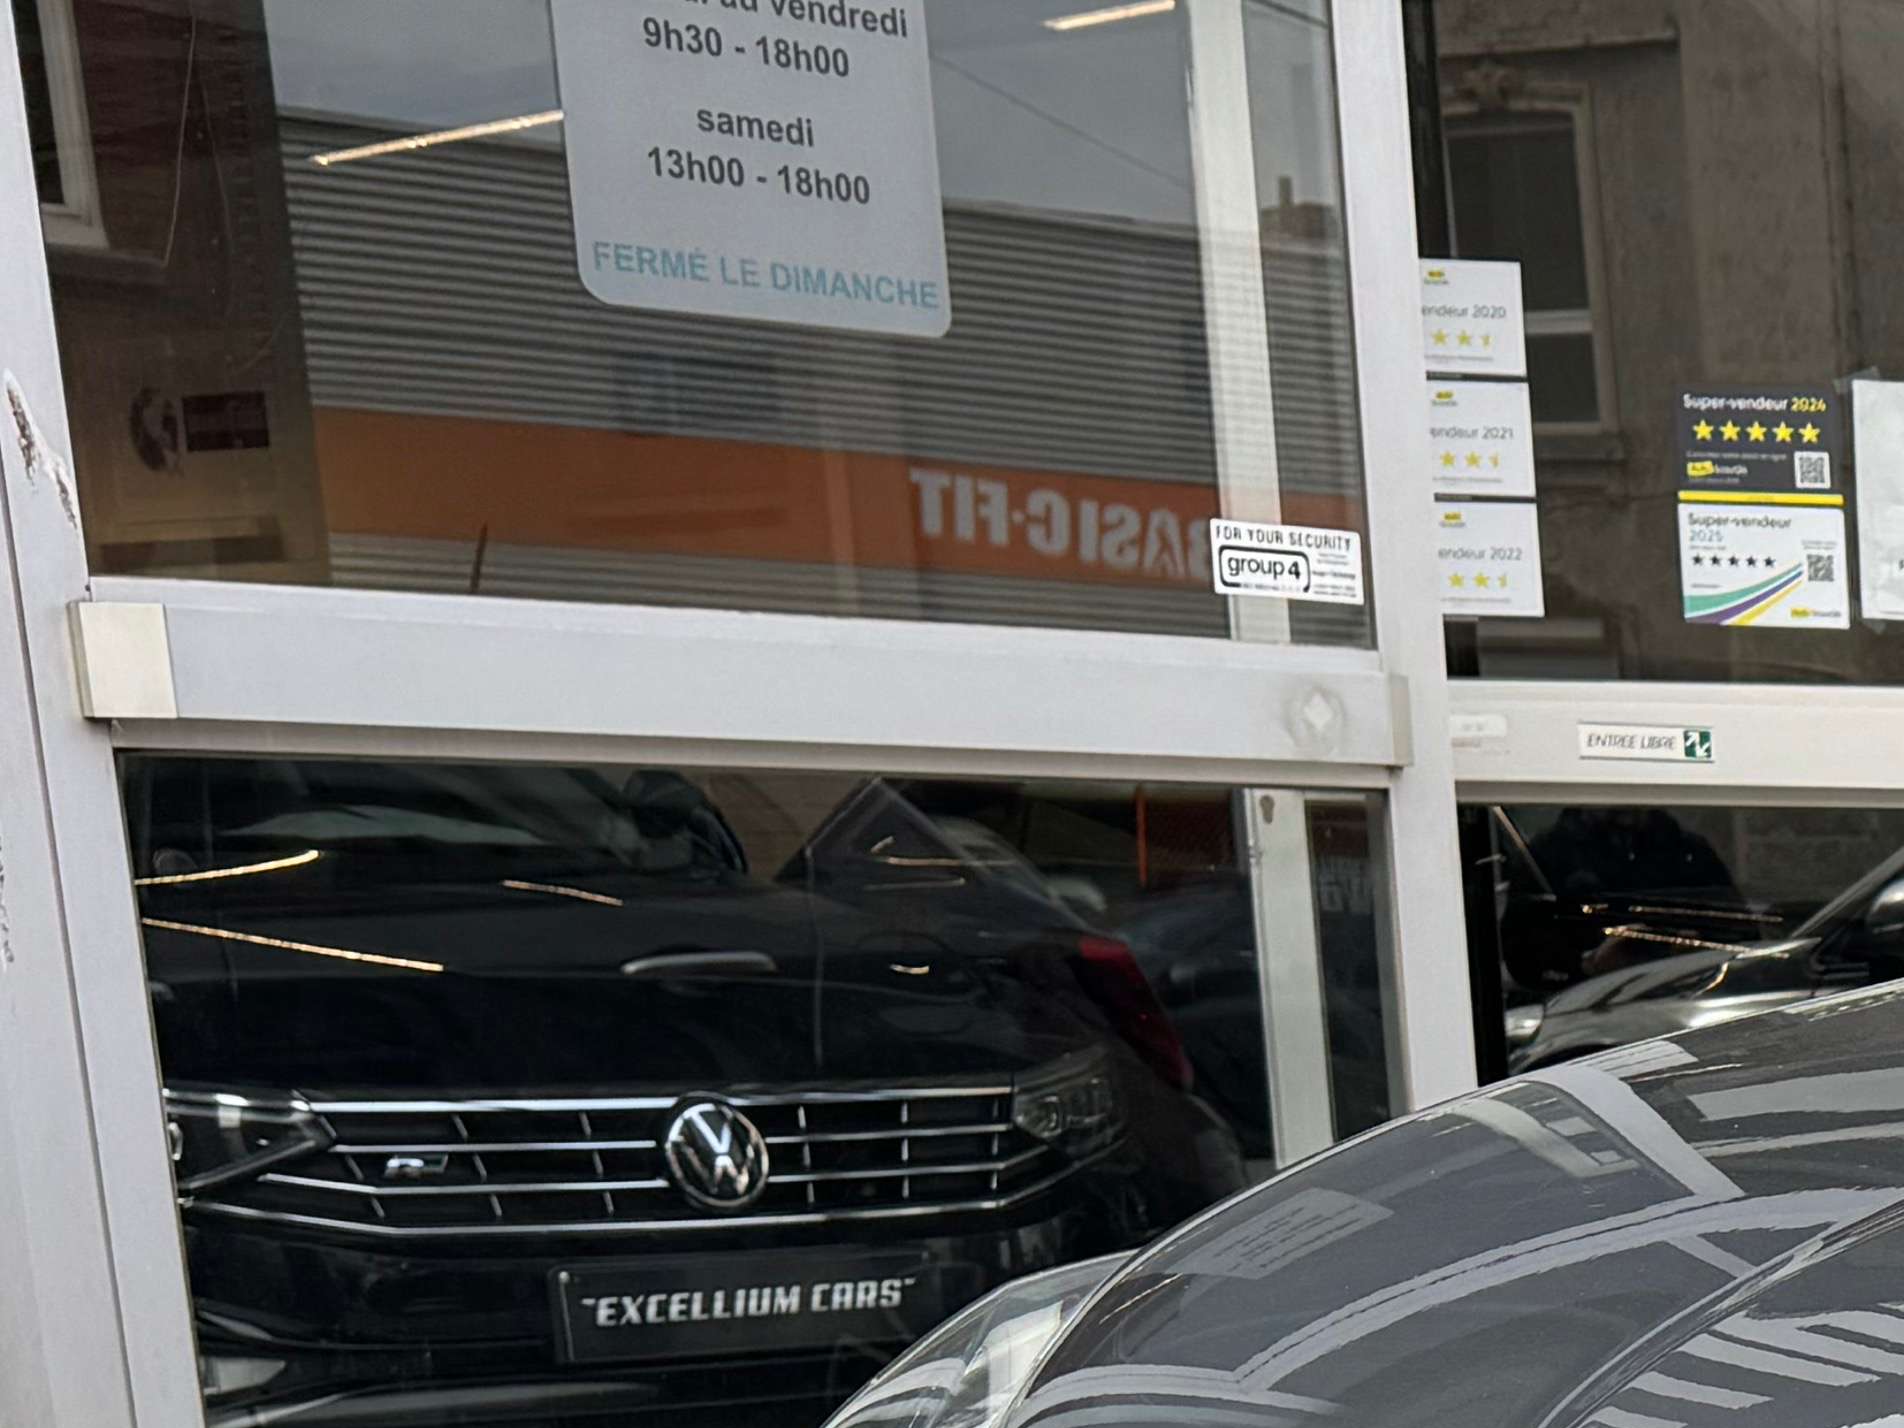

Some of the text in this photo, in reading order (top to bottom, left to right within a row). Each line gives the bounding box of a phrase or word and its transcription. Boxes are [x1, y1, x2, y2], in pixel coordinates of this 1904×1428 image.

[772, 0, 907, 37] vendredi
[643, 17, 722, 57] 9h30
[756, 36, 850, 77] 18h00
[697, 109, 814, 147] samedi
[648, 147, 744, 187] 13h00
[777, 165, 870, 204] 18h00
[721, 256, 760, 288] LE
[771, 262, 939, 309] DIMANCHE
[1228, 556, 1285, 580] group
[1288, 561, 1300, 579] 4
[596, 1278, 903, 1327] EXCELLIUM CARS
